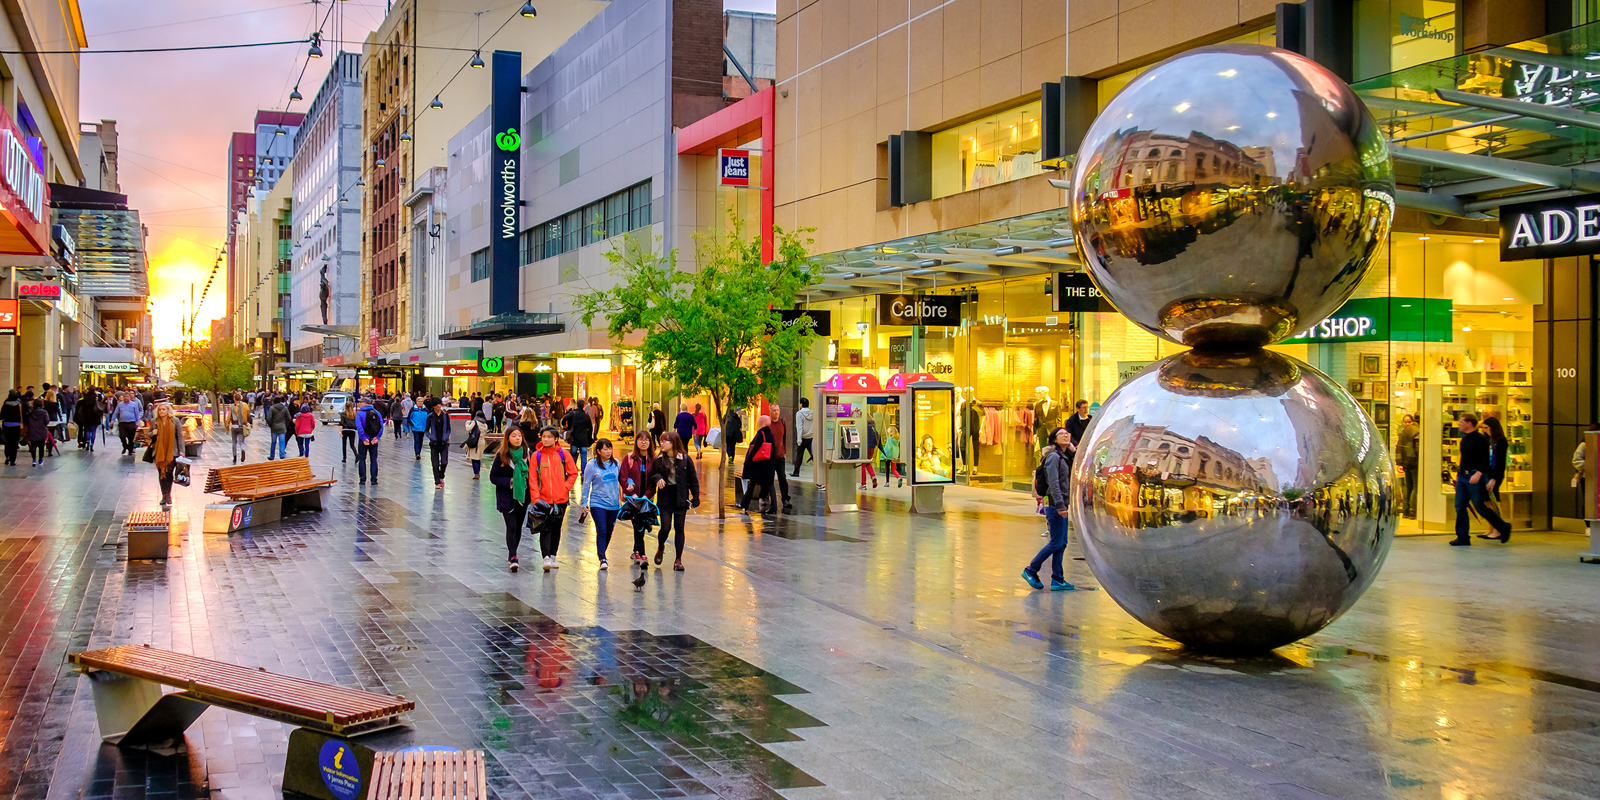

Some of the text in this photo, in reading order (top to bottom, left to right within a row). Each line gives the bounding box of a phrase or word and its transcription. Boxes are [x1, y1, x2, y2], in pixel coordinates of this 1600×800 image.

[727, 156, 745, 168] Just
[724, 165, 747, 178] Jeans
[500, 159, 516, 239] Woolworths
[1508, 204, 1600, 249] ADE
[19, 282, 60, 296] coles
[1065, 286, 1086, 297] THE
[891, 300, 947, 318] Calibre
[1320, 316, 1371, 339] SHOP
[926, 361, 953, 374] Cabre
[1556, 367, 1577, 378] 100
[322, 766, 358, 782] Visitor Information
